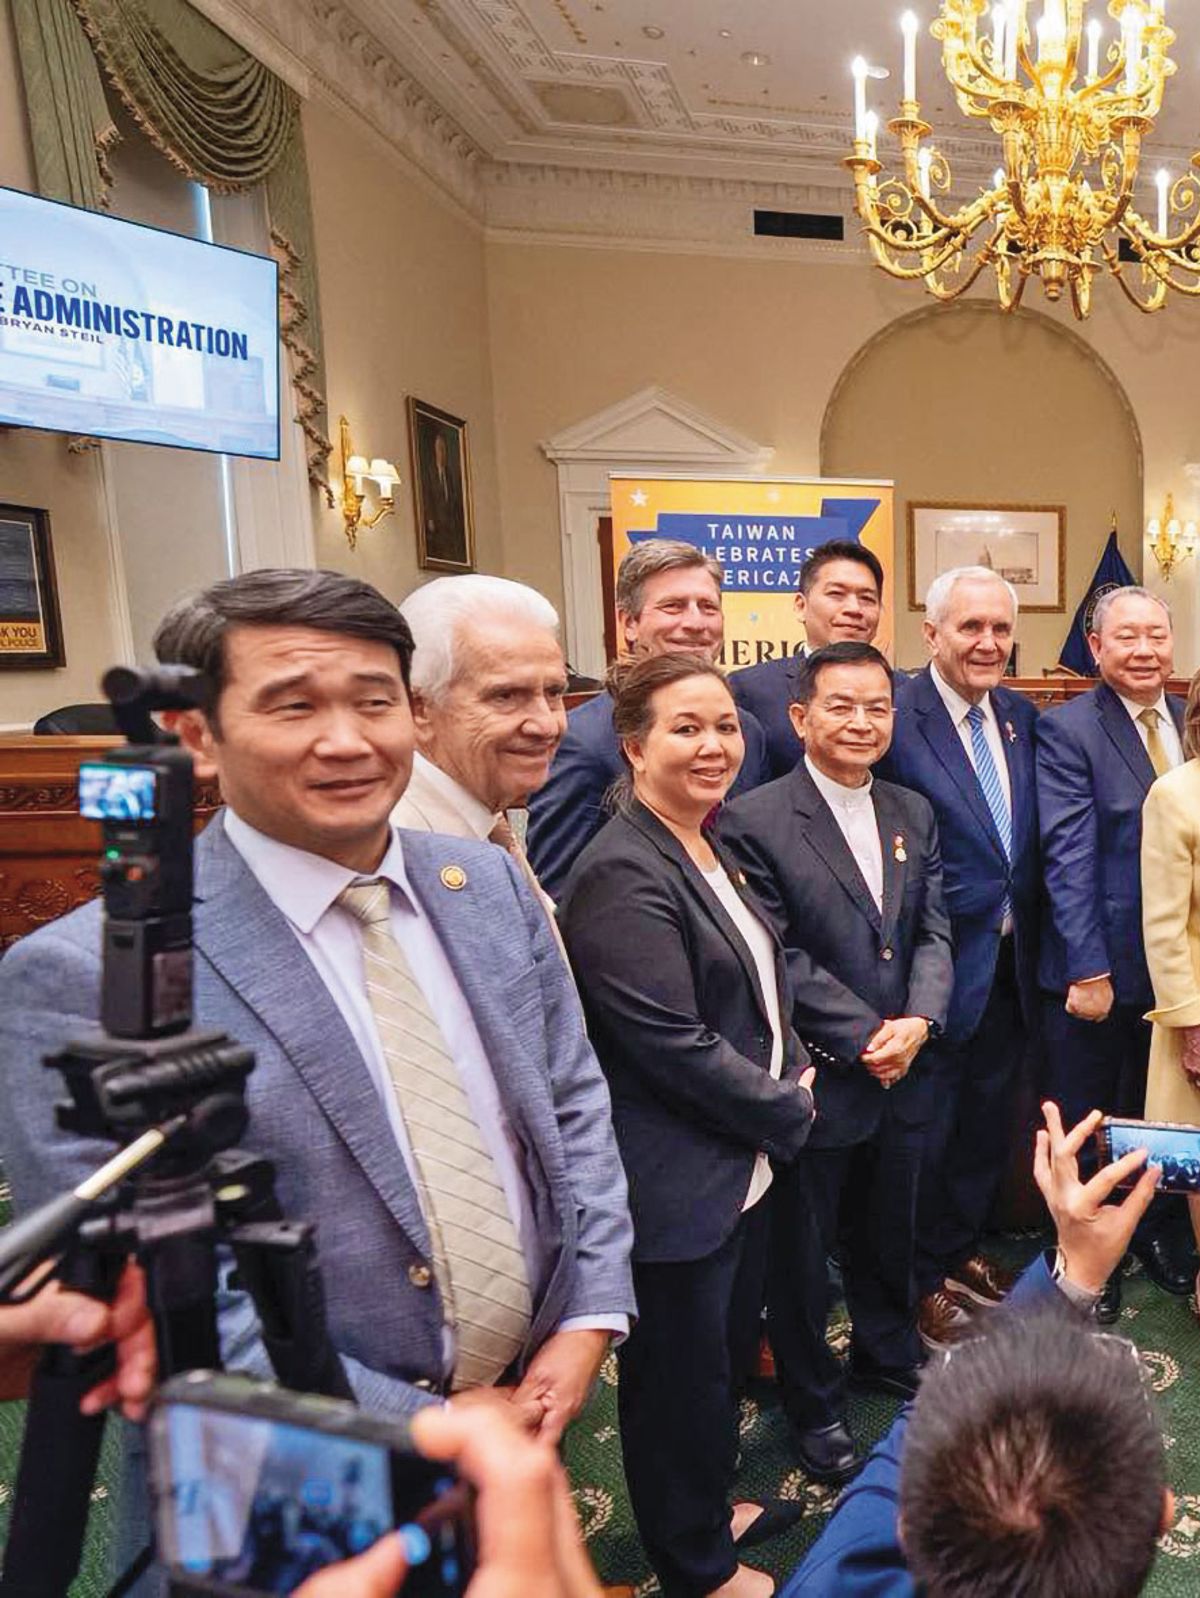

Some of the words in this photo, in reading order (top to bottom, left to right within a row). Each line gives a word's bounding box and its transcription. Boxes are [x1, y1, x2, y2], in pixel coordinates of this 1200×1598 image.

[0, 264, 54, 289] TEE
[62, 278, 97, 298] ON
[0, 316, 54, 334] BRYAN
[60, 328, 104, 345] STEIL
[13, 285, 248, 361] ADMINISTRATION
[707, 523, 795, 541] TAIWAN
[723, 569, 801, 587] ERICA2
[11, 626, 37, 638] YOU
